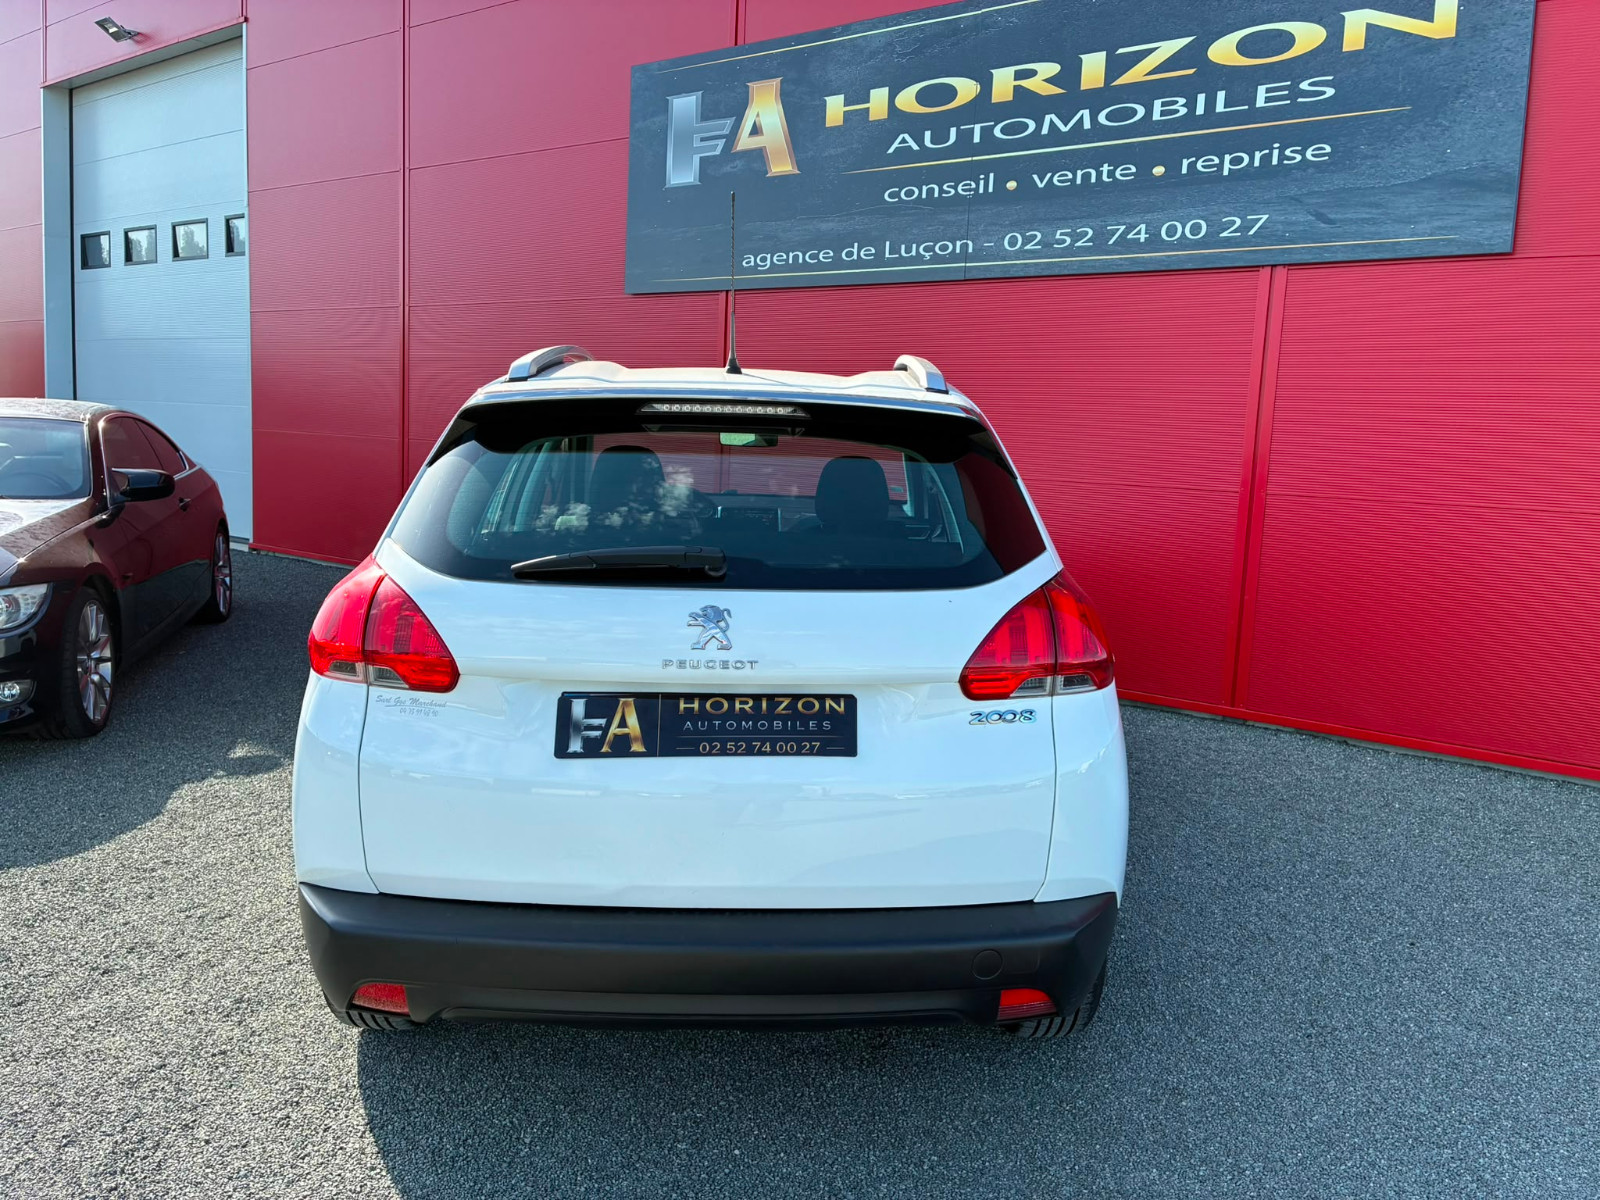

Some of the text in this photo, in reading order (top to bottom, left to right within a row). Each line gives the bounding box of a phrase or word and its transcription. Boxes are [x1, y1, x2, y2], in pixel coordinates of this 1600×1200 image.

[824, 0, 1458, 128] HORIZON
[887, 76, 1336, 154] AUTOMOBILES
[884, 143, 1332, 202] conseil vente reprise
[742, 248, 834, 270] agence
[841, 243, 876, 261] de
[885, 239, 974, 261] Luçon
[1003, 231, 1042, 251] 02
[1053, 228, 1094, 248] 52
[1106, 223, 1149, 245] 74
[1160, 219, 1207, 241] 00
[1219, 214, 1269, 237] 27
[661, 659, 759, 670] PEUGEOT
[678, 697, 845, 715] HORIZON
[683, 720, 832, 731] AUTOMOBILES
[969, 709, 1037, 725] 2008
[699, 741, 821, 754] 02 52 74 00 27
